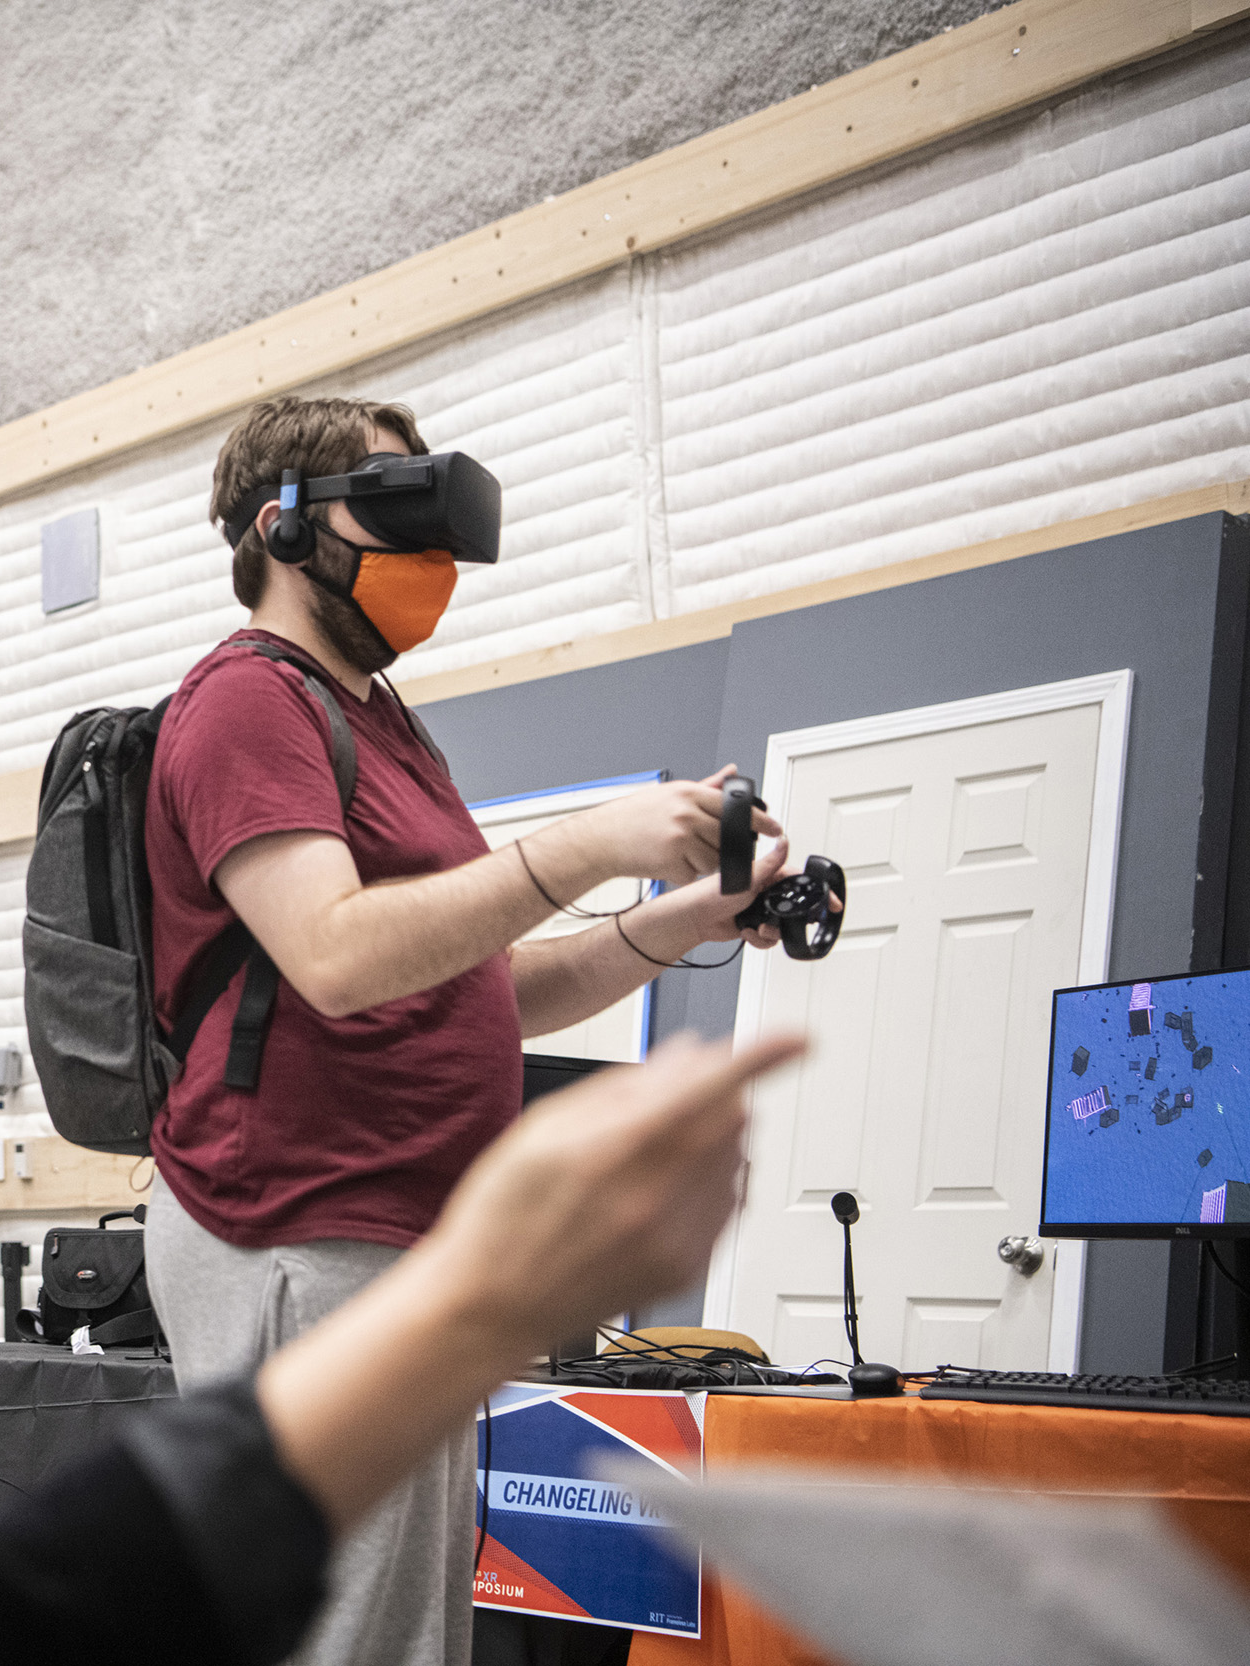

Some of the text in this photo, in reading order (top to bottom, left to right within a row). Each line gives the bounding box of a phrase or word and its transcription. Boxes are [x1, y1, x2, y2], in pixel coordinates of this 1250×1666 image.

[503, 1480, 633, 1516] CHANGELING
[482, 1570, 498, 1584] XR
[649, 1611, 665, 1624] RIT
